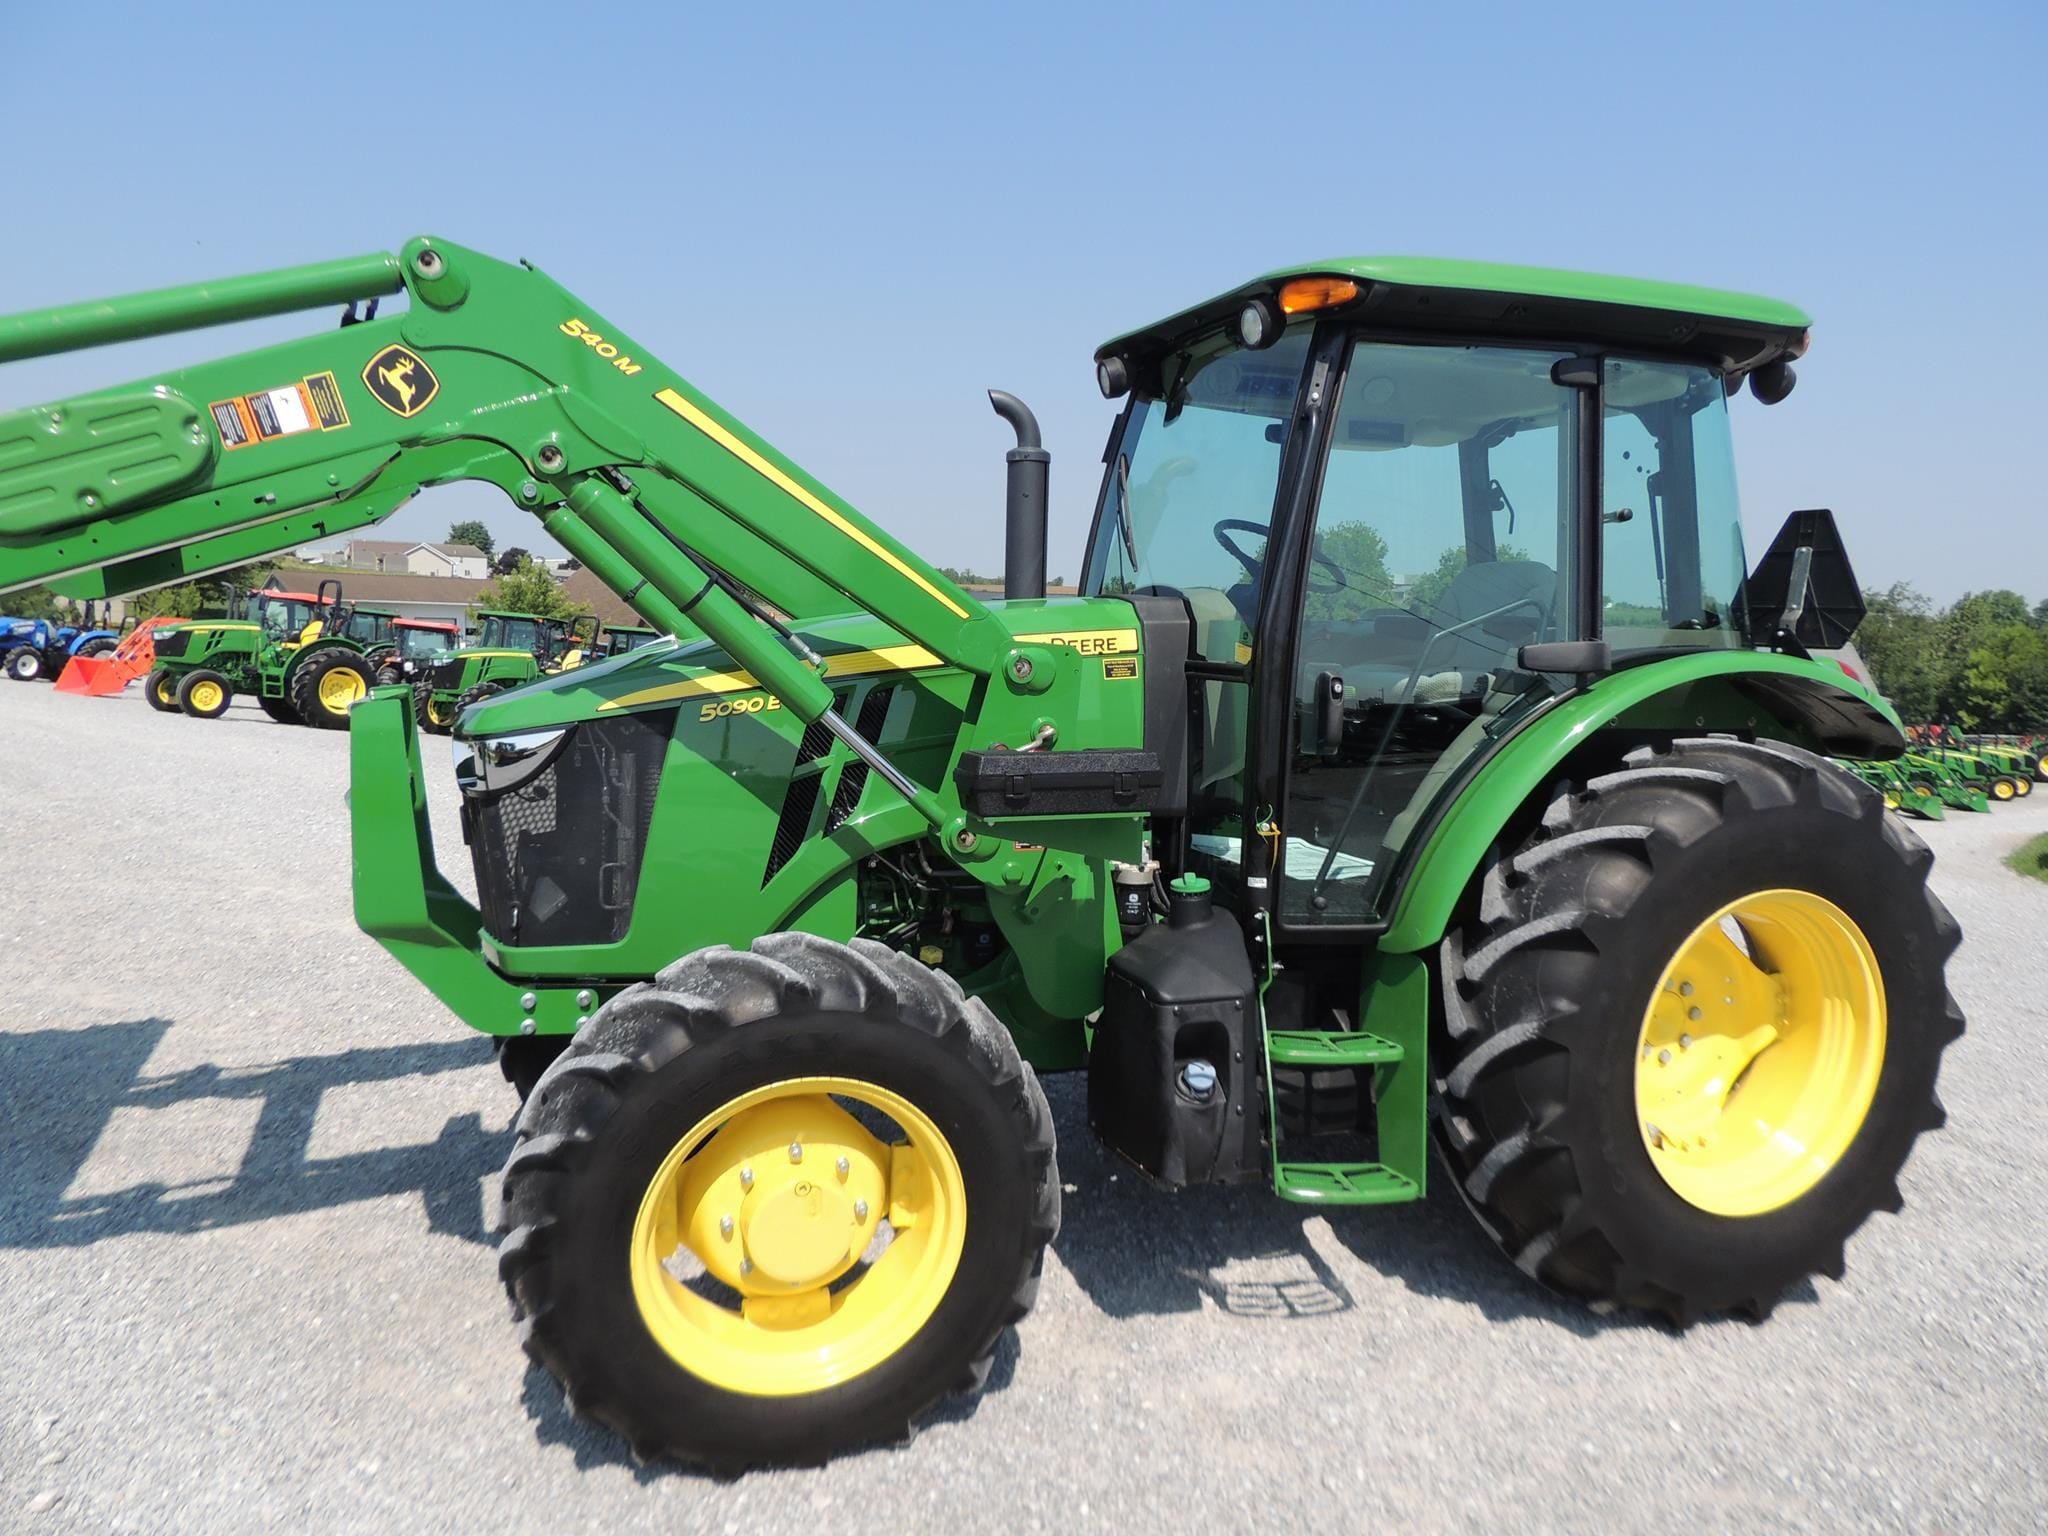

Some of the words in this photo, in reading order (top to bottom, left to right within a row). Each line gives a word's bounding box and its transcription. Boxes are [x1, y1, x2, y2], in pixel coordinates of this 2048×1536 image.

[559, 318, 618, 357] 540
[612, 356, 643, 375] M
[699, 696, 764, 722] 5090
[767, 695, 781, 711] E
